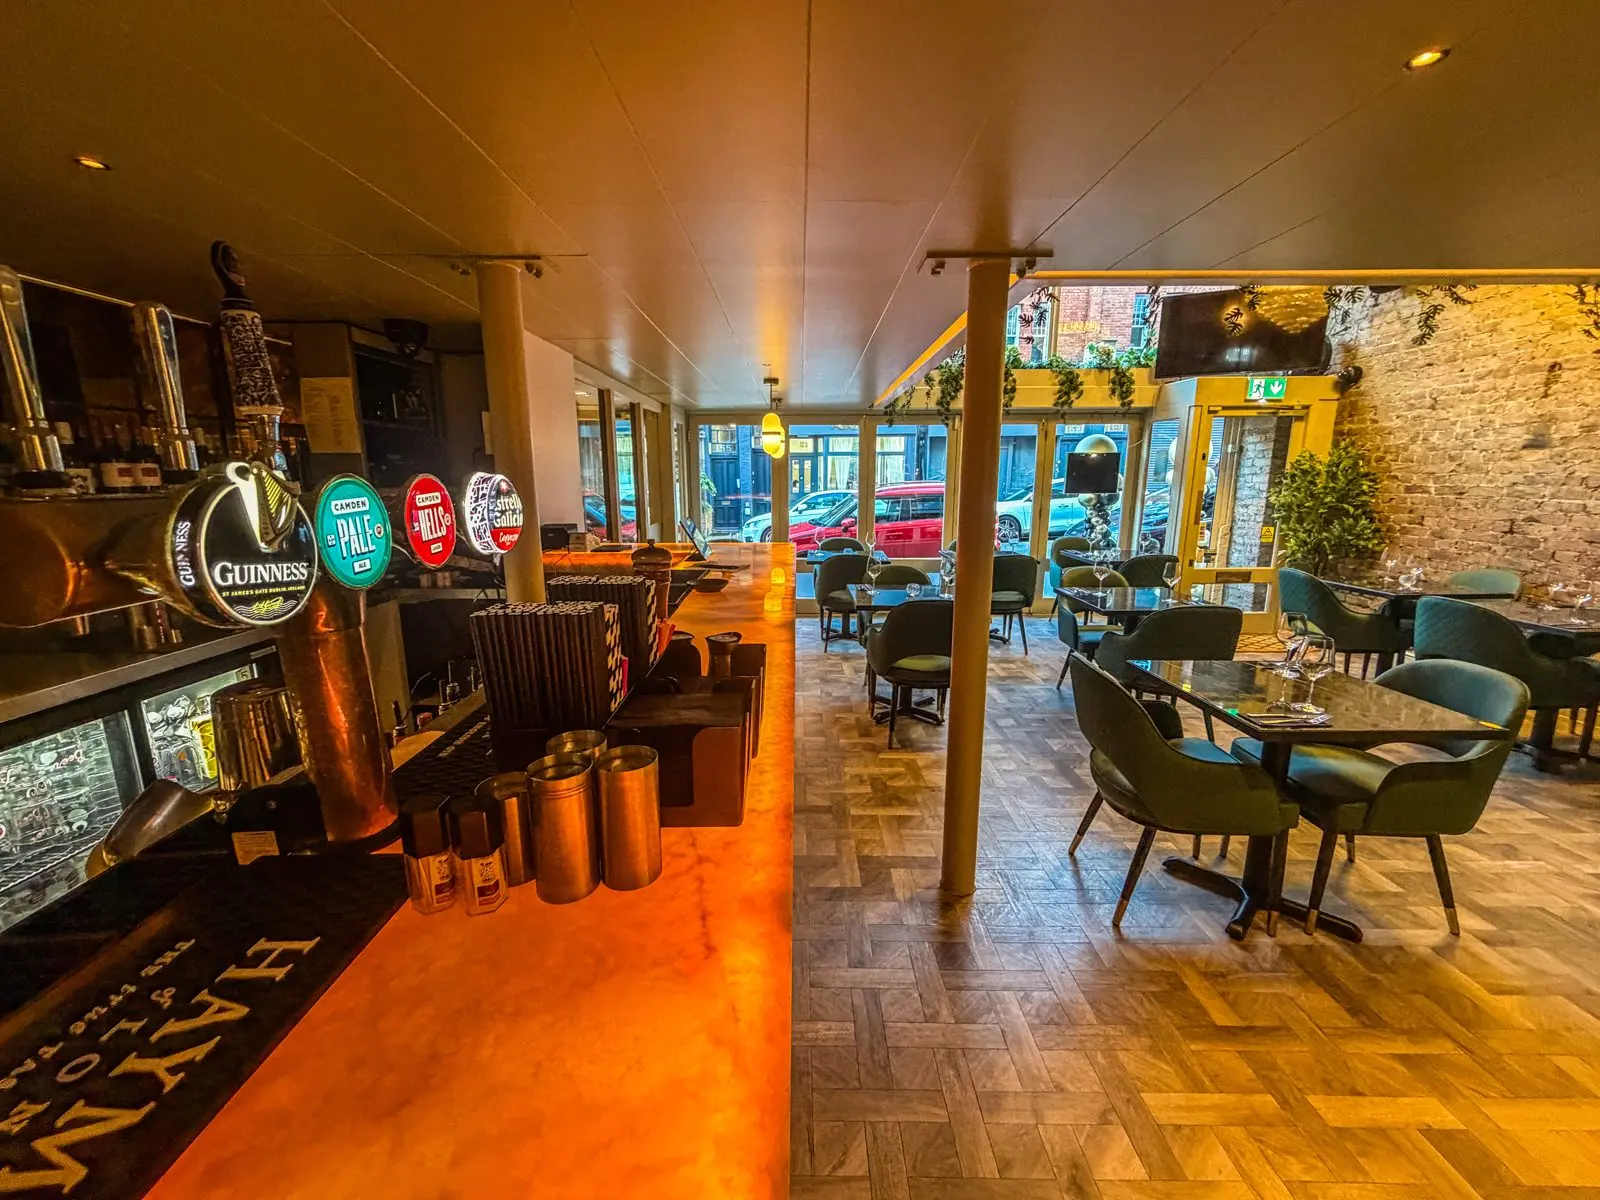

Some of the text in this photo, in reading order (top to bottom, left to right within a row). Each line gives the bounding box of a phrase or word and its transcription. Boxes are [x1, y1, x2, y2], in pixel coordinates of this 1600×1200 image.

[333, 500, 367, 512] CAMDEN
[417, 495, 440, 504] CAMDEN
[495, 493, 522, 511] strell
[336, 514, 377, 560] PALE
[418, 506, 447, 542] HELLS
[175, 521, 195, 586] GUINNESS
[358, 561, 367, 569] ALE
[214, 561, 309, 586] GUINNESS
[140, 938, 196, 977] THE
[68, 984, 137, 1036] true
